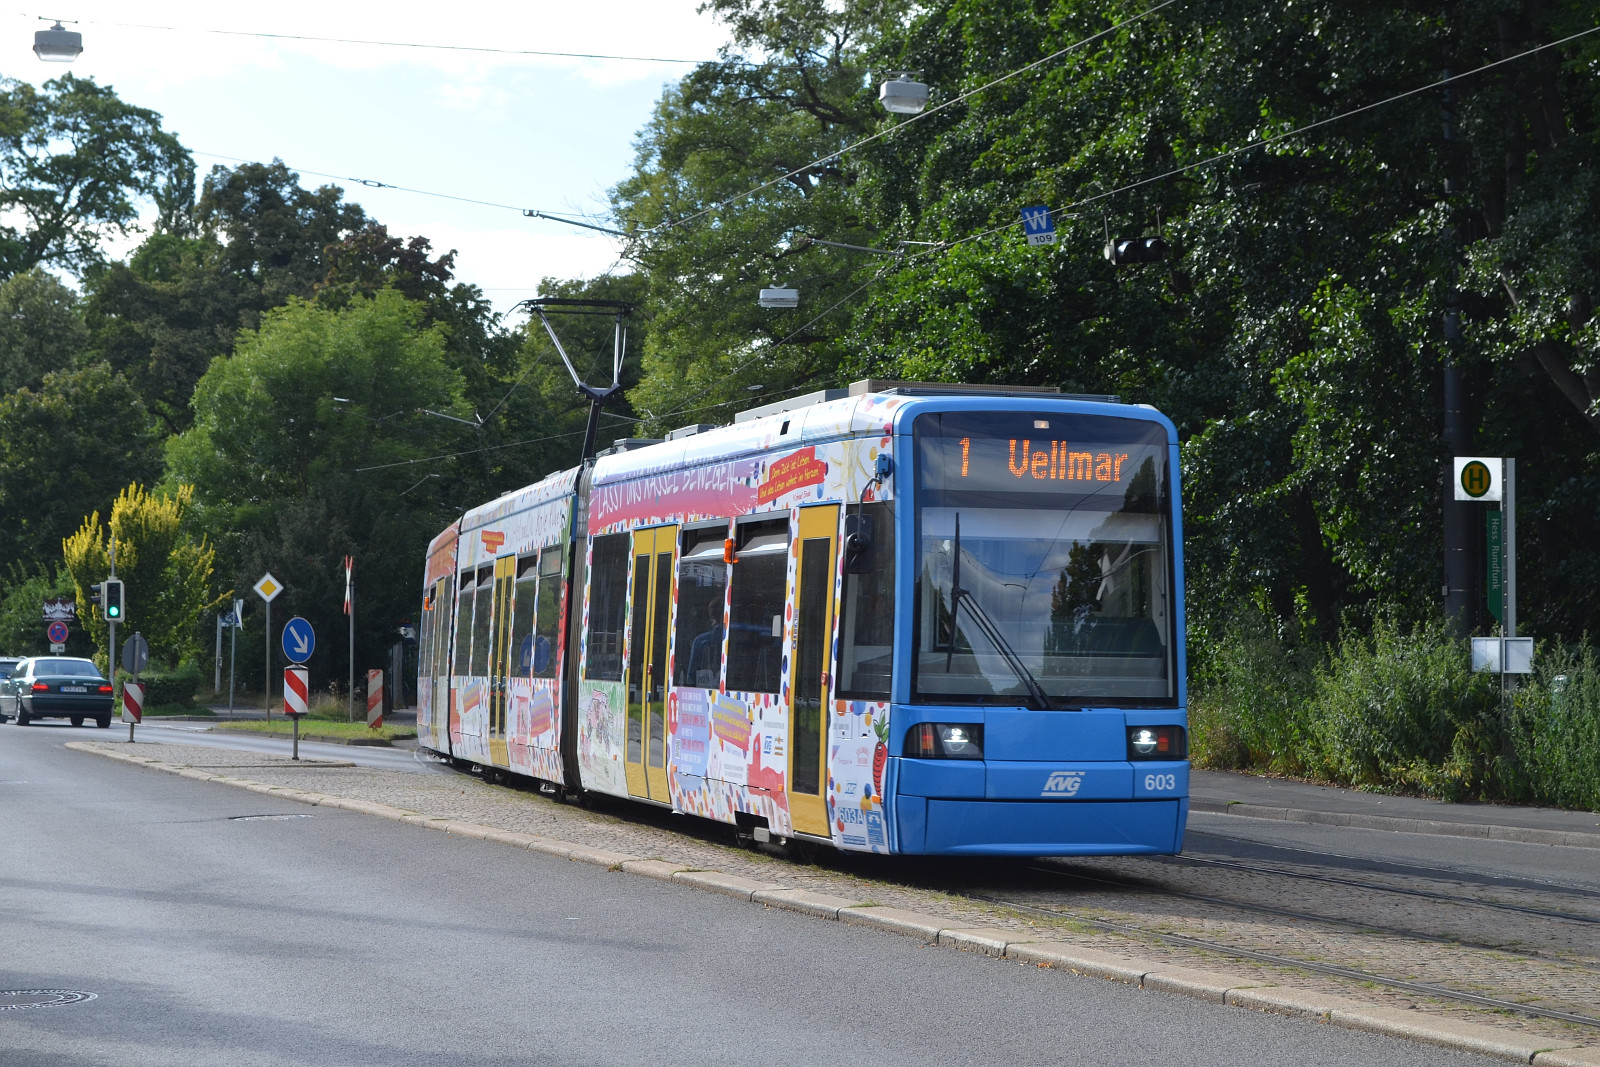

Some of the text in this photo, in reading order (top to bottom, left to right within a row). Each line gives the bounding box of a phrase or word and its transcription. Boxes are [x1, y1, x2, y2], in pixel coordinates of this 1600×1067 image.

[1025, 210, 1047, 230] W
[1034, 234, 1052, 243] 109
[957, 437, 1129, 482] 1 Vellmar
[1469, 468, 1484, 490] H
[1491, 545, 1501, 590] Rundfunk
[1042, 774, 1176, 793] KVG 603
[839, 808, 864, 824] 603A
